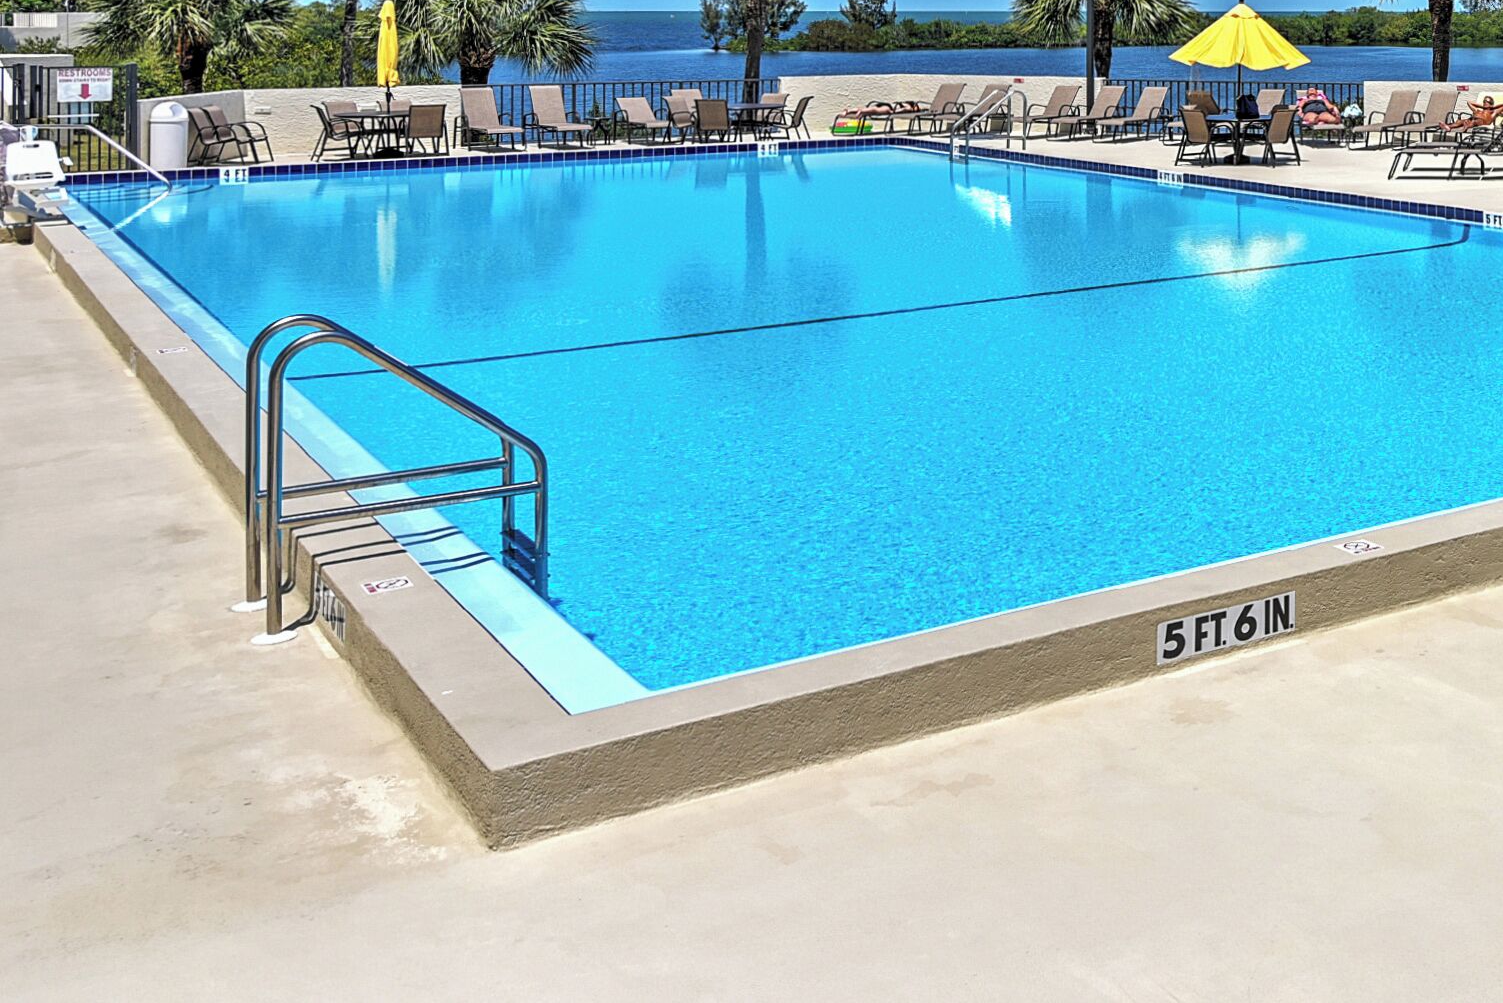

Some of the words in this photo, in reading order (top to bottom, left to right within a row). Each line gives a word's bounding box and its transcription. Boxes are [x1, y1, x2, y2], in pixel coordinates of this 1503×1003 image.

[58, 68, 112, 77] RESTROOMS
[224, 169, 230, 177] 4
[235, 169, 247, 177] FT
[1486, 214, 1491, 224] 5
[1493, 215, 1503, 226] FT
[1163, 620, 1186, 659] 5
[1194, 611, 1227, 652] FT.
[1234, 604, 1258, 642] 6
[1264, 594, 1294, 636] IN.
